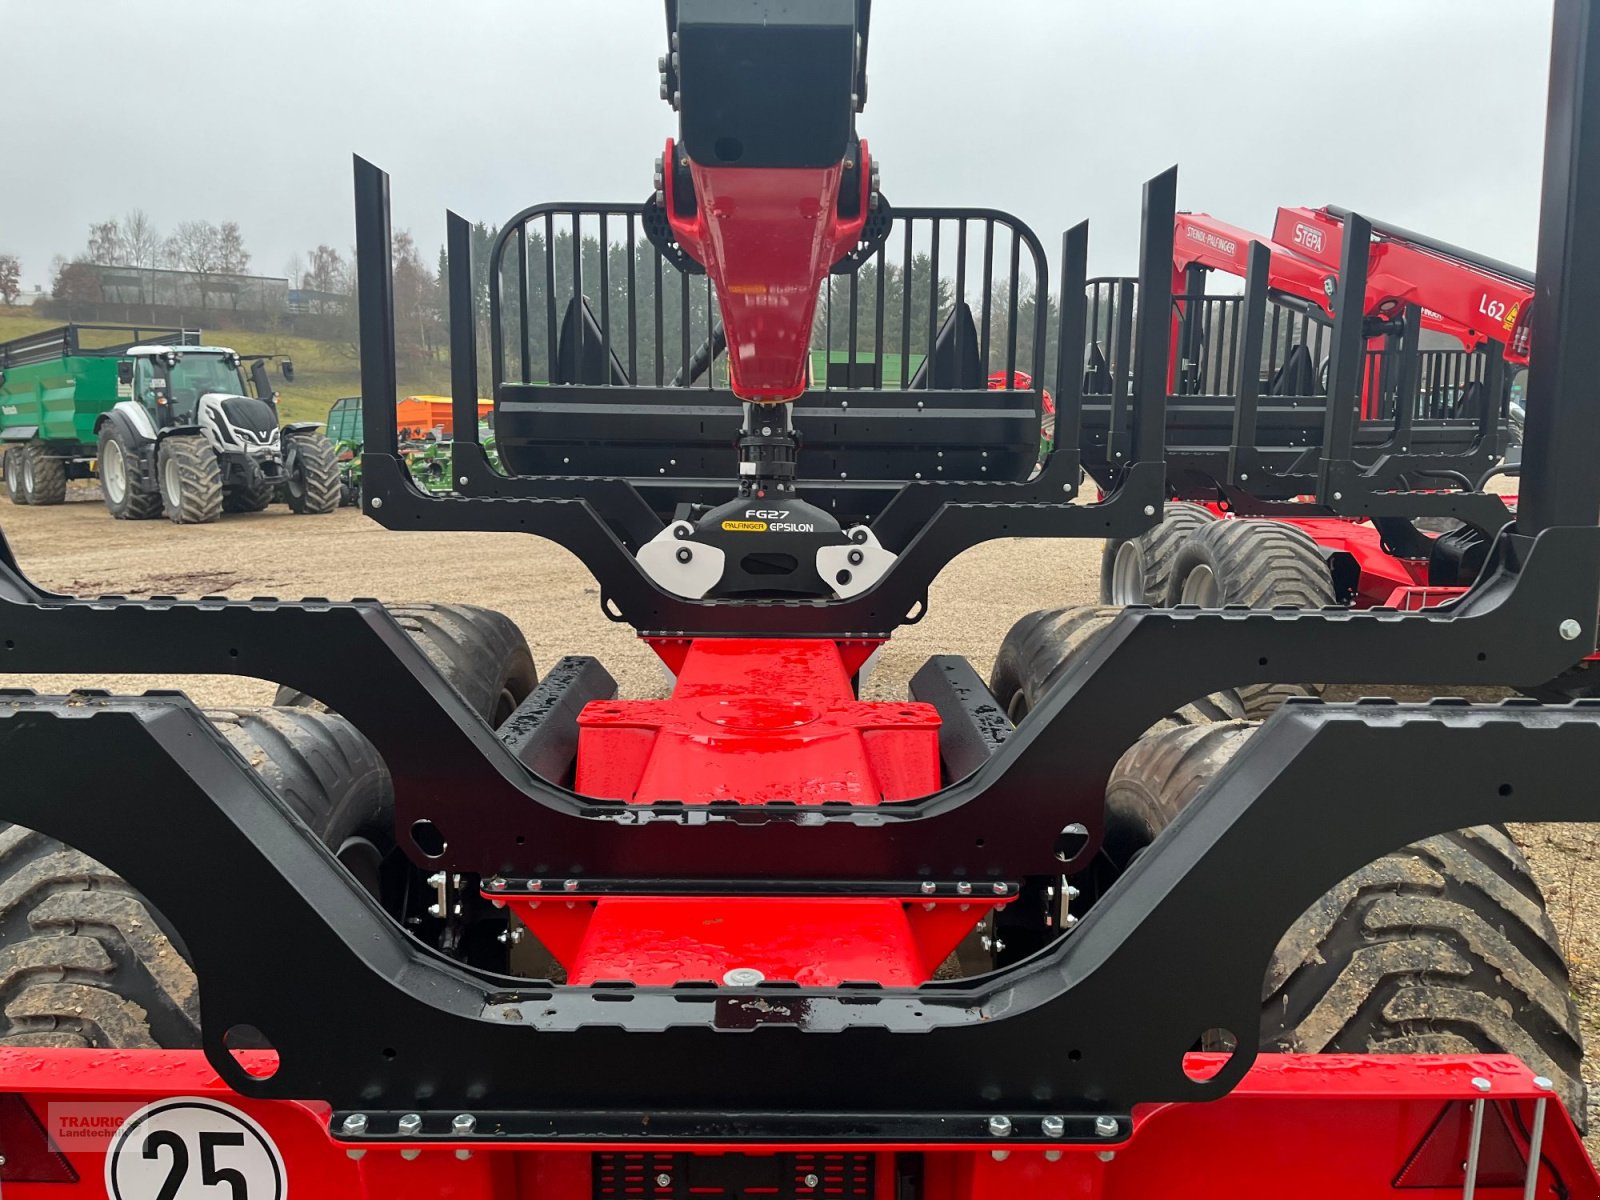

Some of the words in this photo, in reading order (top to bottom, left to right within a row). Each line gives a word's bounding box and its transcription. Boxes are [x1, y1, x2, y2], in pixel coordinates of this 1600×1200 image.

[1186, 226, 1236, 254] STEINDL-PALFINGER
[1294, 223, 1321, 252] STEPA
[1479, 293, 1505, 321] L62
[724, 522, 764, 530] PALFINGER
[769, 522, 814, 533] EPSILON
[745, 509, 790, 519] FG27
[141, 1129, 248, 1200] 25
